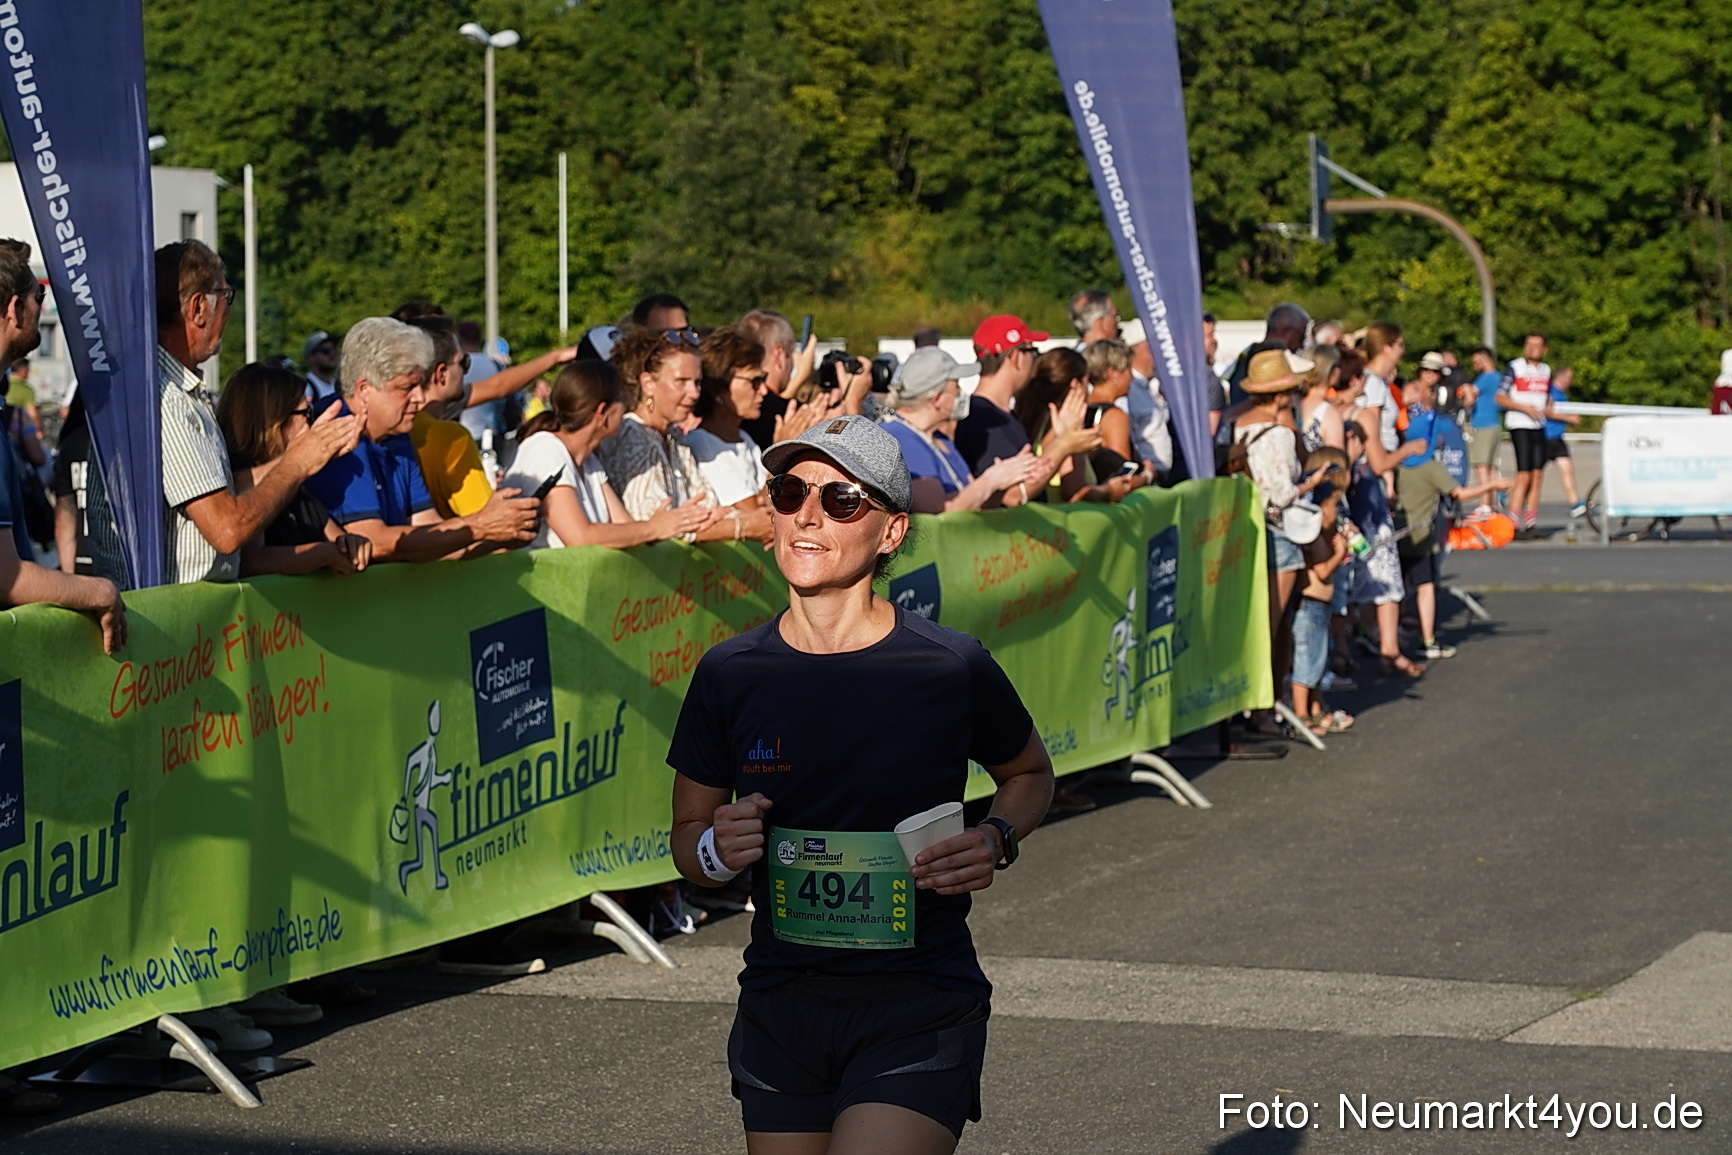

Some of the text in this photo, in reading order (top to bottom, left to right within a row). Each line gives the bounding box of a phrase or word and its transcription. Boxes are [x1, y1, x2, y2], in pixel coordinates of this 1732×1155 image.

[110, 611, 304, 718] Gesunde Firmen
[486, 657, 535, 692] Fischer
[161, 653, 330, 775] laufen länger!
[748, 737, 781, 760] aha!
[763, 763, 775, 773] bei
[777, 763, 792, 772] mir
[448, 699, 627, 847] firmenlauf
[455, 823, 528, 876] neumarkt
[797, 852, 844, 862] Firmenlauf
[775, 879, 787, 918] RUN
[797, 871, 875, 910] 494
[893, 879, 907, 932] 2022
[786, 908, 892, 924] Rummel Anna-Maria
